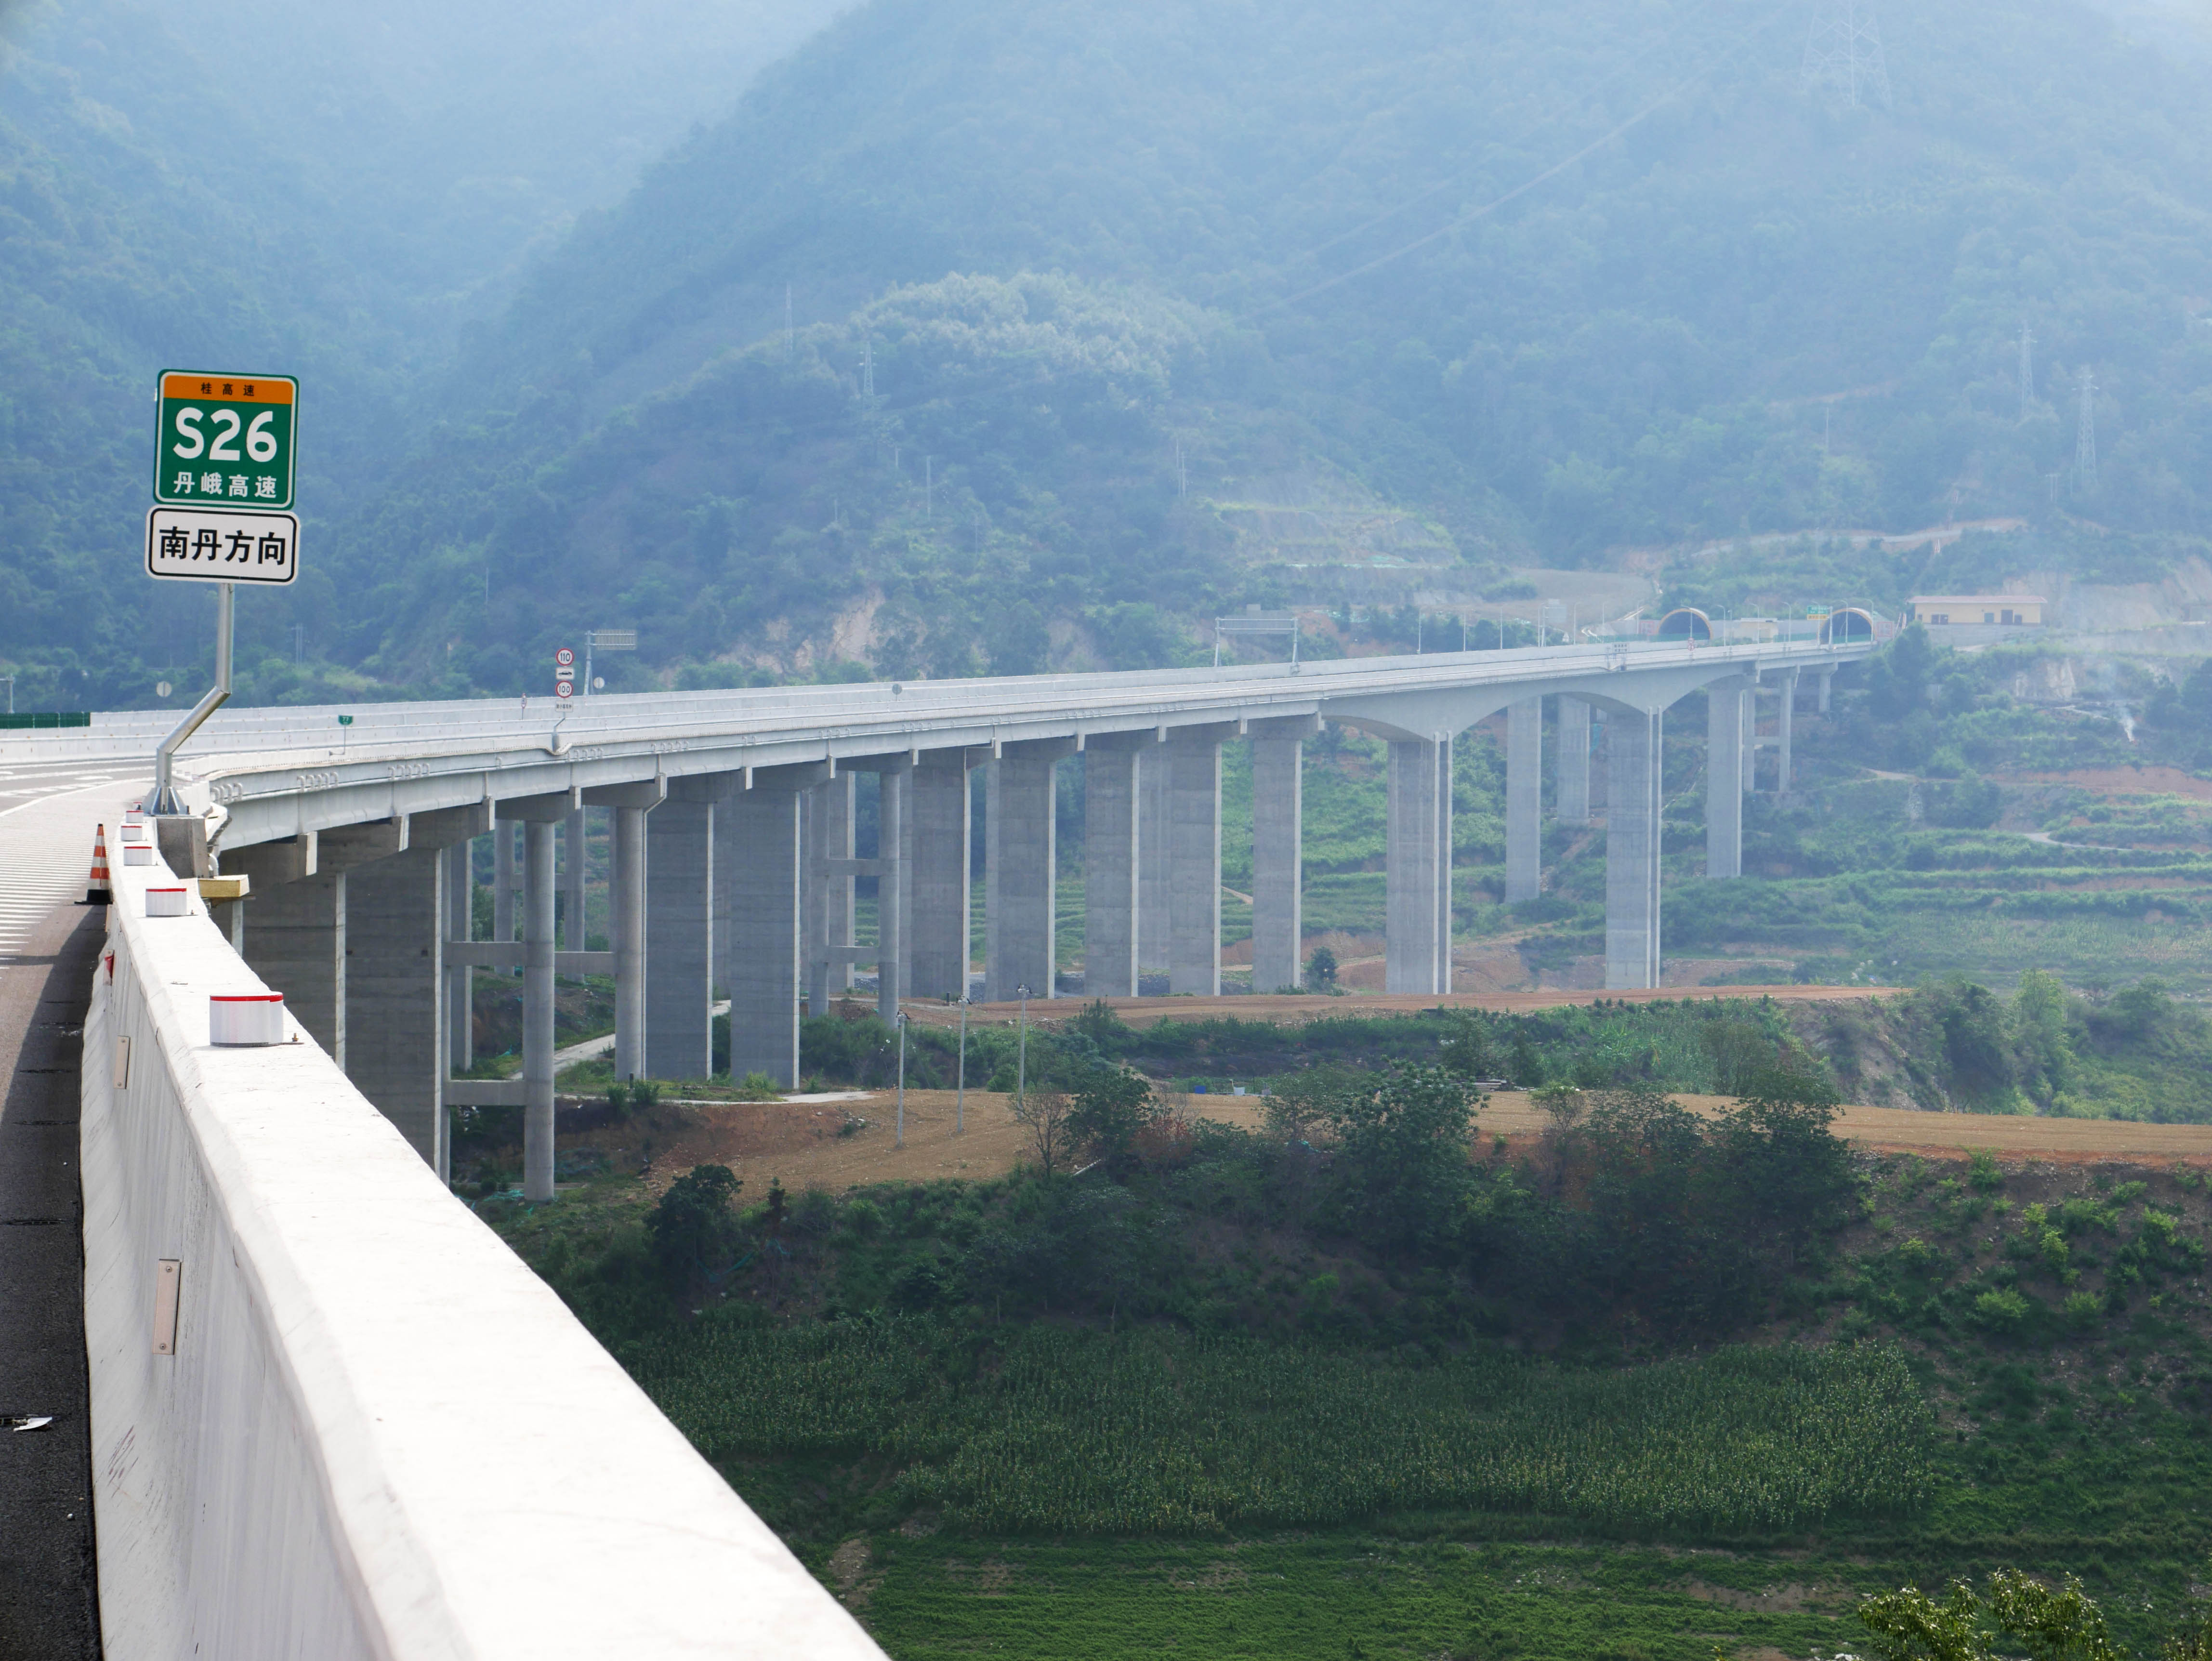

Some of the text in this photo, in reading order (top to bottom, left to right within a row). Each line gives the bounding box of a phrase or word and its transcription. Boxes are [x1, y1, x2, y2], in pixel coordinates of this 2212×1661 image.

[200, 382, 255, 396] 桂高速
[173, 407, 277, 462] S26
[173, 472, 277, 499] 丹峨高速
[159, 526, 286, 566] 南丹方向
[560, 653, 570, 661] 110
